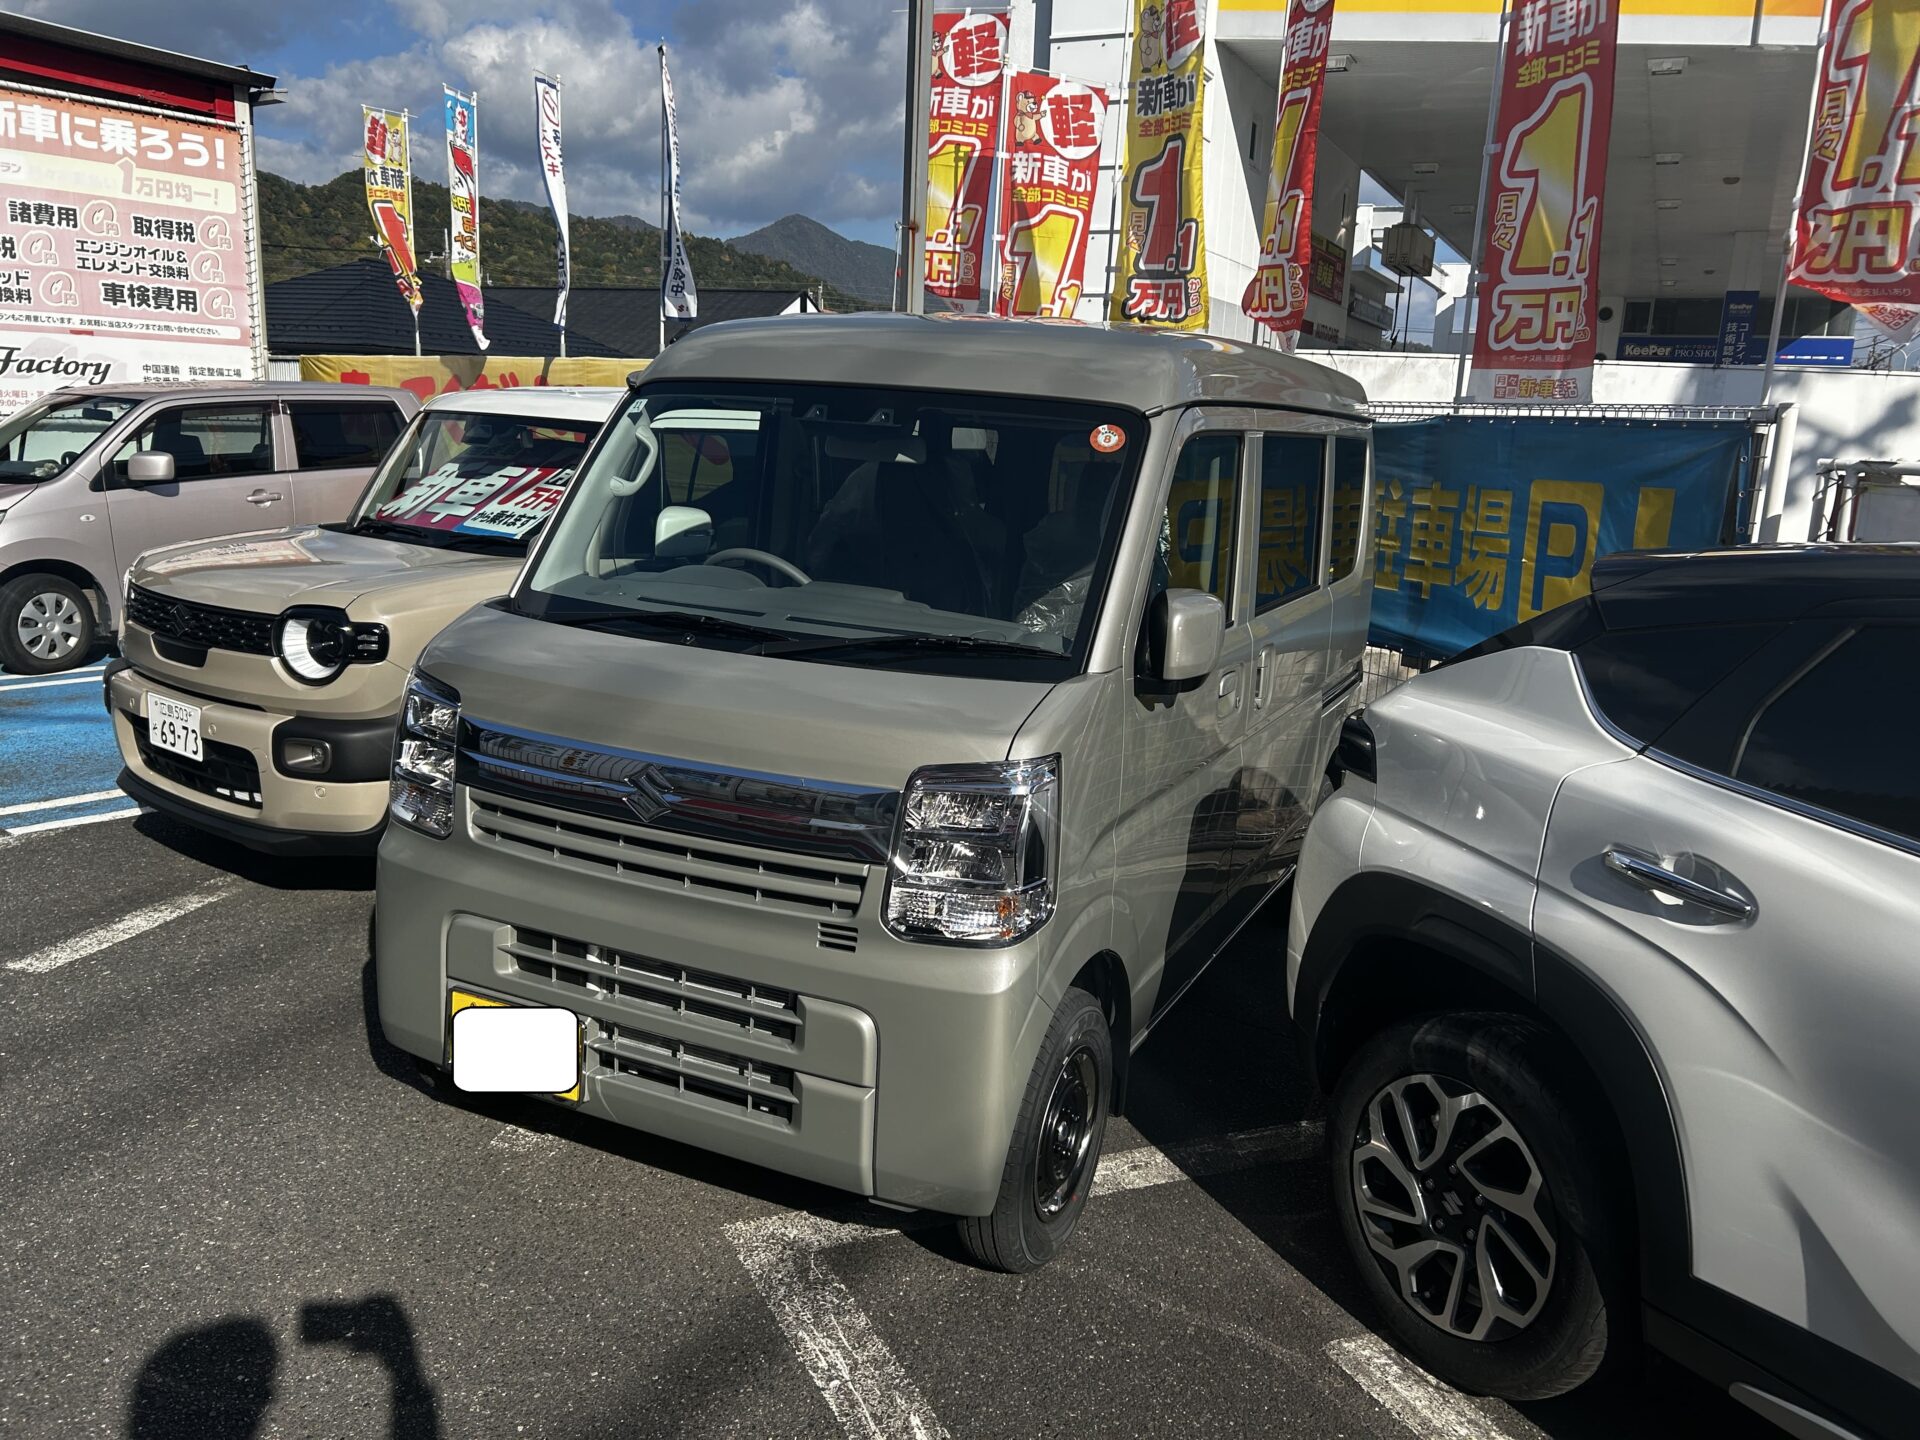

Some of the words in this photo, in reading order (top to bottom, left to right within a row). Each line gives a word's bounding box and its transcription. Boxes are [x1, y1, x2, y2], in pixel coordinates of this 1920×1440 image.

[950, 20, 1002, 79] 軽
[1136, 72, 1196, 116] 新車が
[1047, 93, 1098, 149] 軽
[1011, 151, 1092, 192] 新車が
[8, 200, 78, 229] 諸費用
[1012, 186, 1089, 211] 全部コミコミ
[133, 216, 196, 243] 取得税
[1493, 191, 1521, 251] 月々
[76, 239, 188, 264] エンジンオイル&
[77, 256, 190, 281] エレメント交換料
[101, 281, 199, 314] 車検費用
[1492, 283, 1588, 350] 万円
[1625, 344, 1671, 357] KeePer
[1674, 349, 1693, 357] PRO
[1696, 349, 1717, 358] SHO
[381, 462, 526, 524] 新車
[174, 705, 189, 723] 503
[161, 719, 199, 756] 69-73
